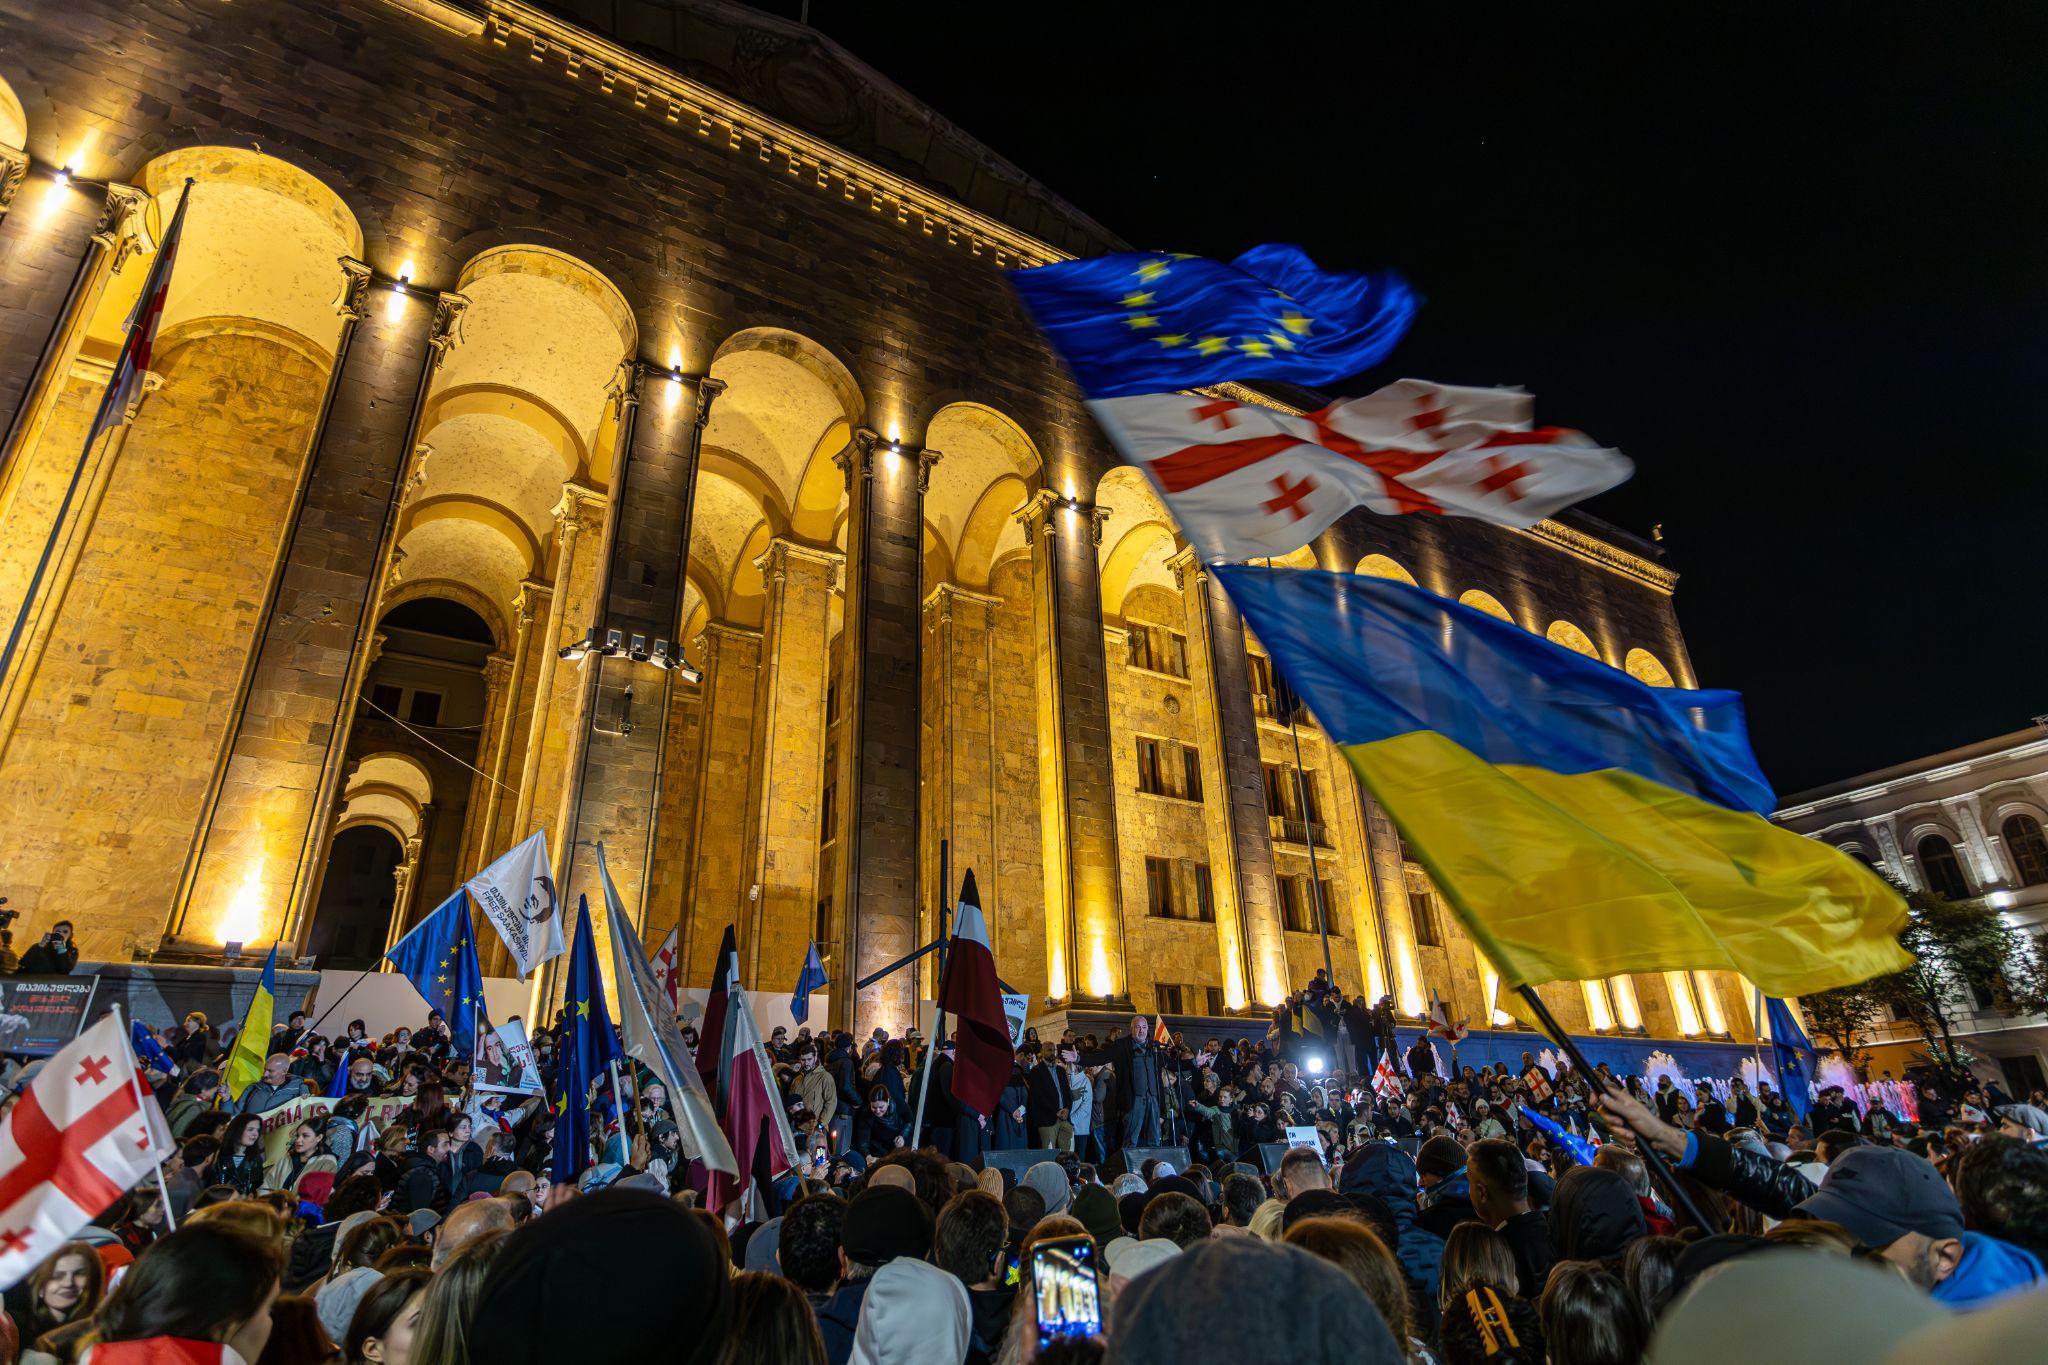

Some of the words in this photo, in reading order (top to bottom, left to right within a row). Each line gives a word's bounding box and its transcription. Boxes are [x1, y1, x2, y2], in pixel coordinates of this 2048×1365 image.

[482, 891, 500, 913] FREE
[497, 912, 529, 962] SAAKASHVIL
[489, 886, 525, 935] თავისუფლება
[15, 983, 92, 993] თავისუფლება
[310, 1104, 330, 1119] IS
